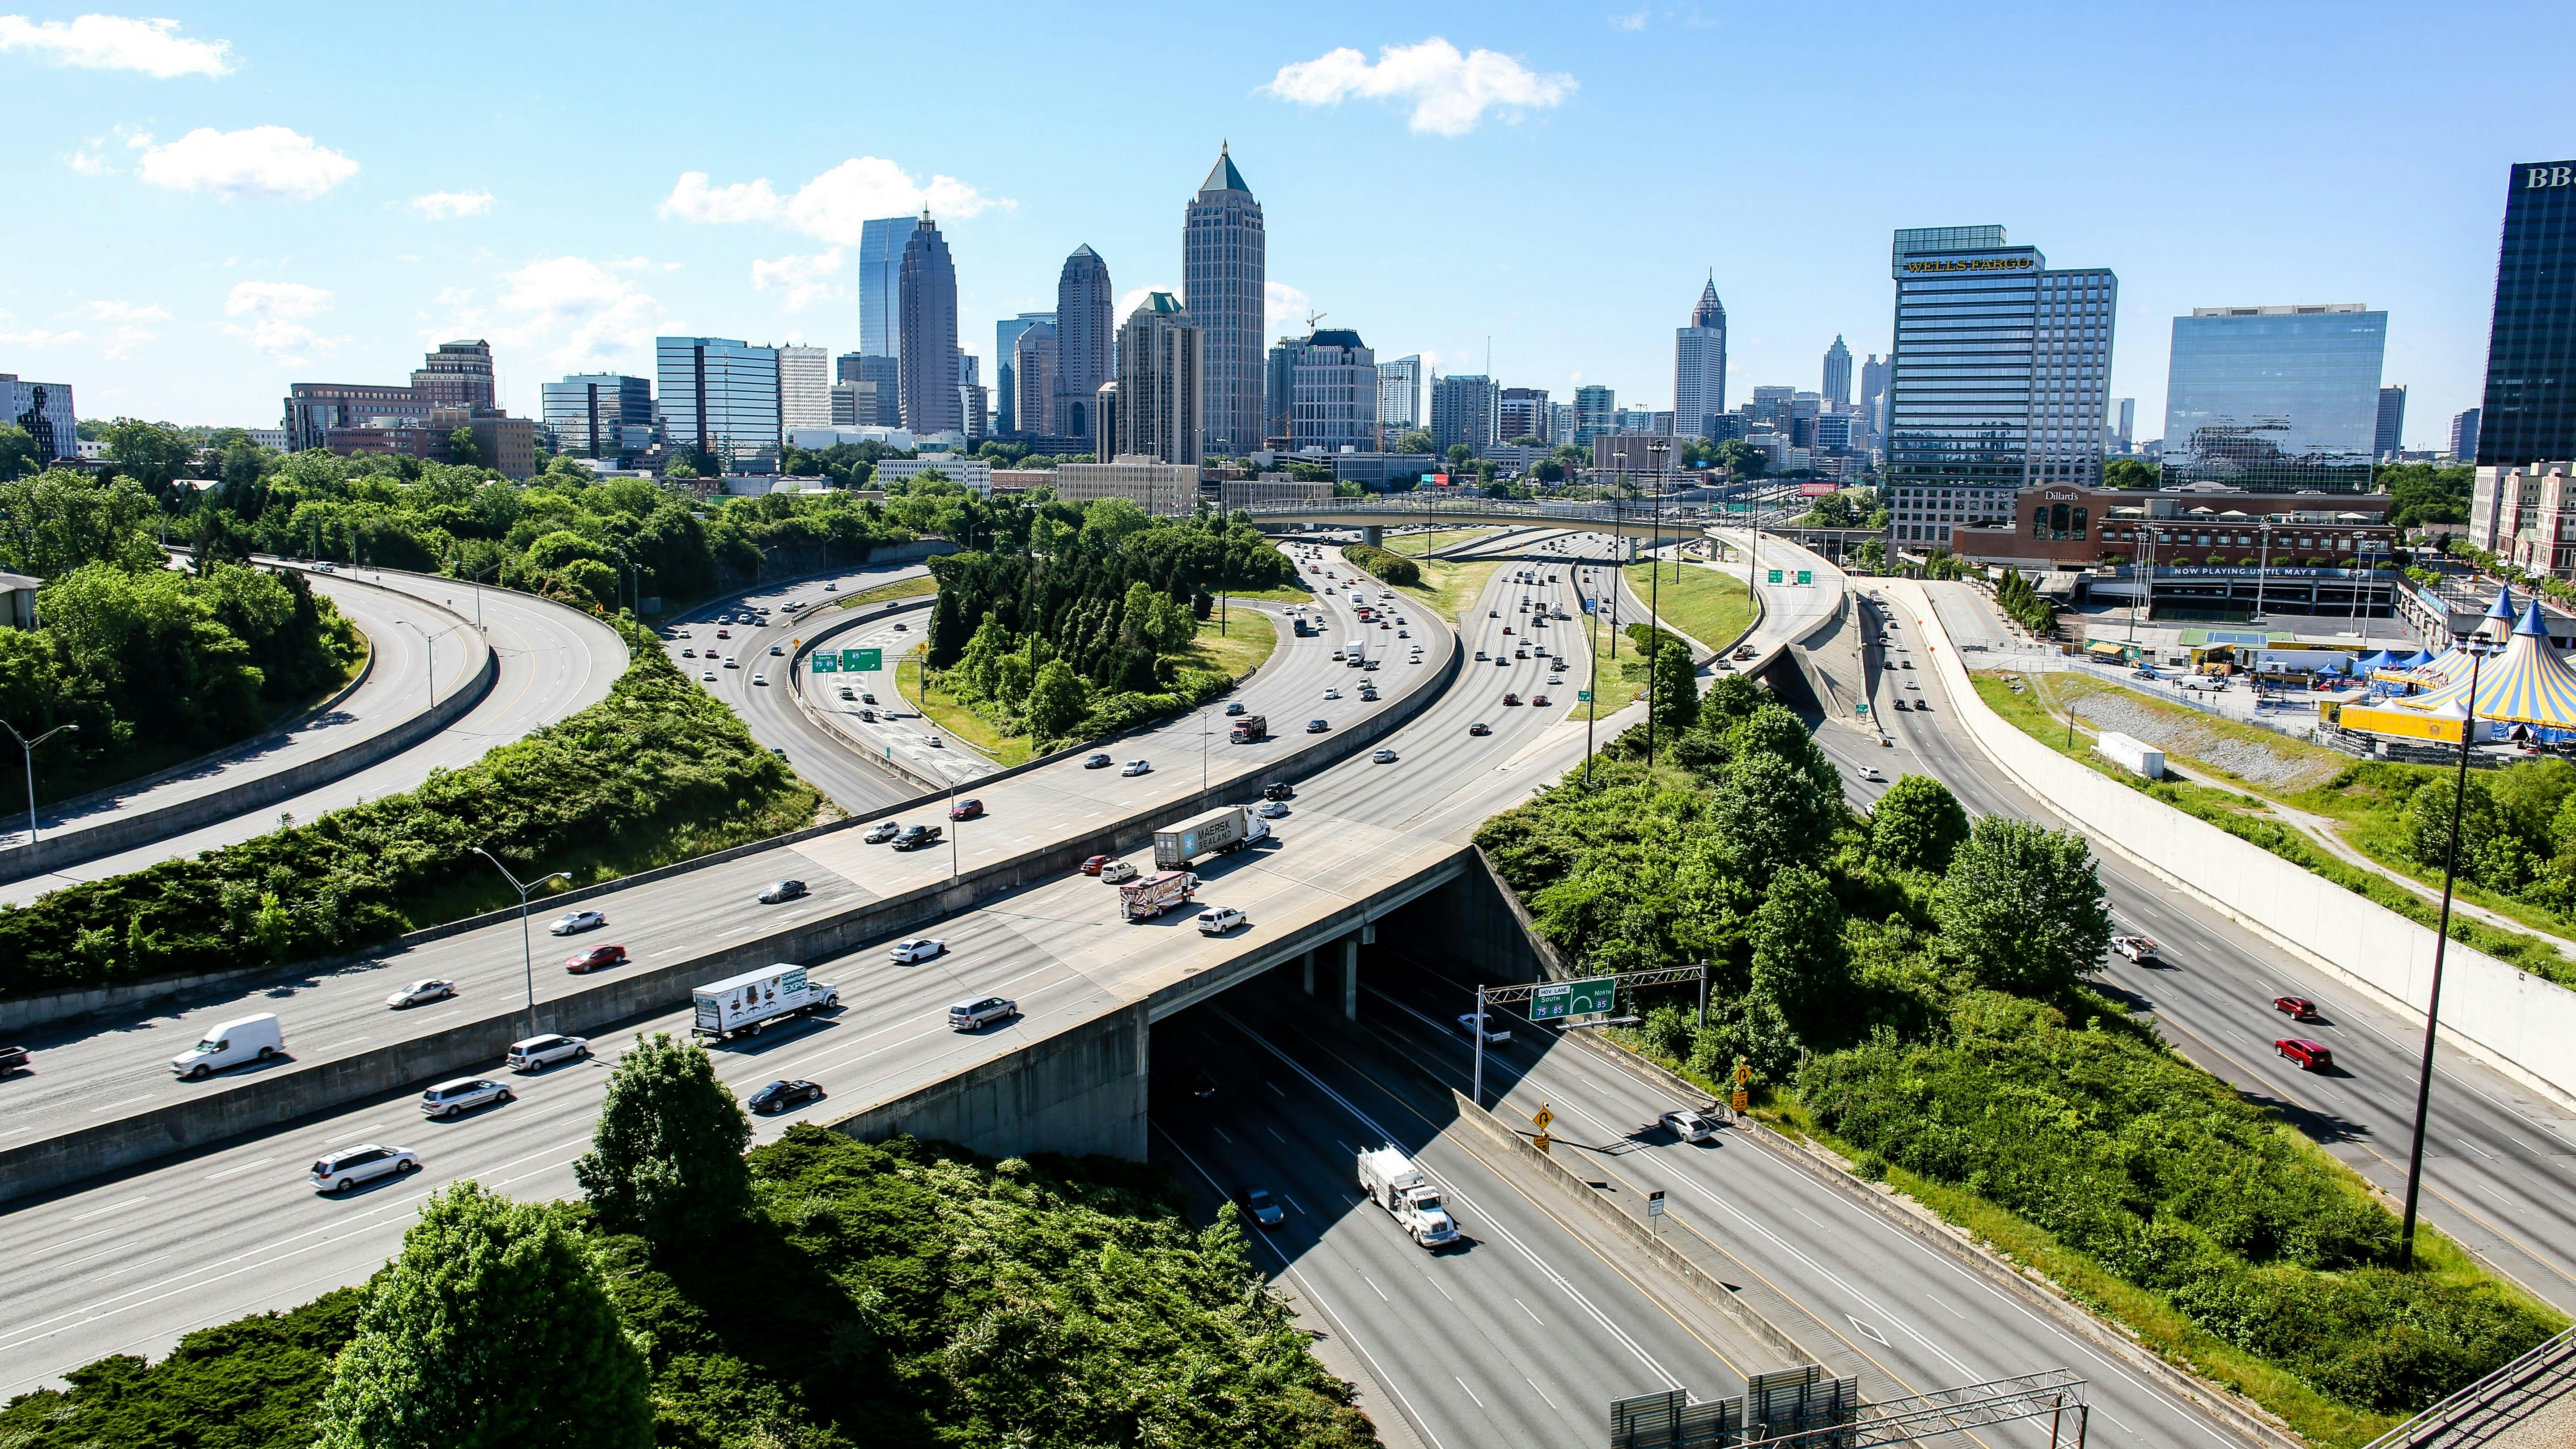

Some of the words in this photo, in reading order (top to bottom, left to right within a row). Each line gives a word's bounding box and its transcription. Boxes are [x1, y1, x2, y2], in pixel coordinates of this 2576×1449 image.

[2525, 167, 2576, 188] BB
[1907, 260, 1966, 272] WELLS
[1971, 258, 2030, 271] FARGO
[2045, 491, 2079, 500] Dillard's
[1198, 819, 1231, 840] MAERSK
[1199, 830, 1231, 849] SEALAND
[783, 968, 807, 979] OFFICE
[784, 980, 807, 993] EXPO
